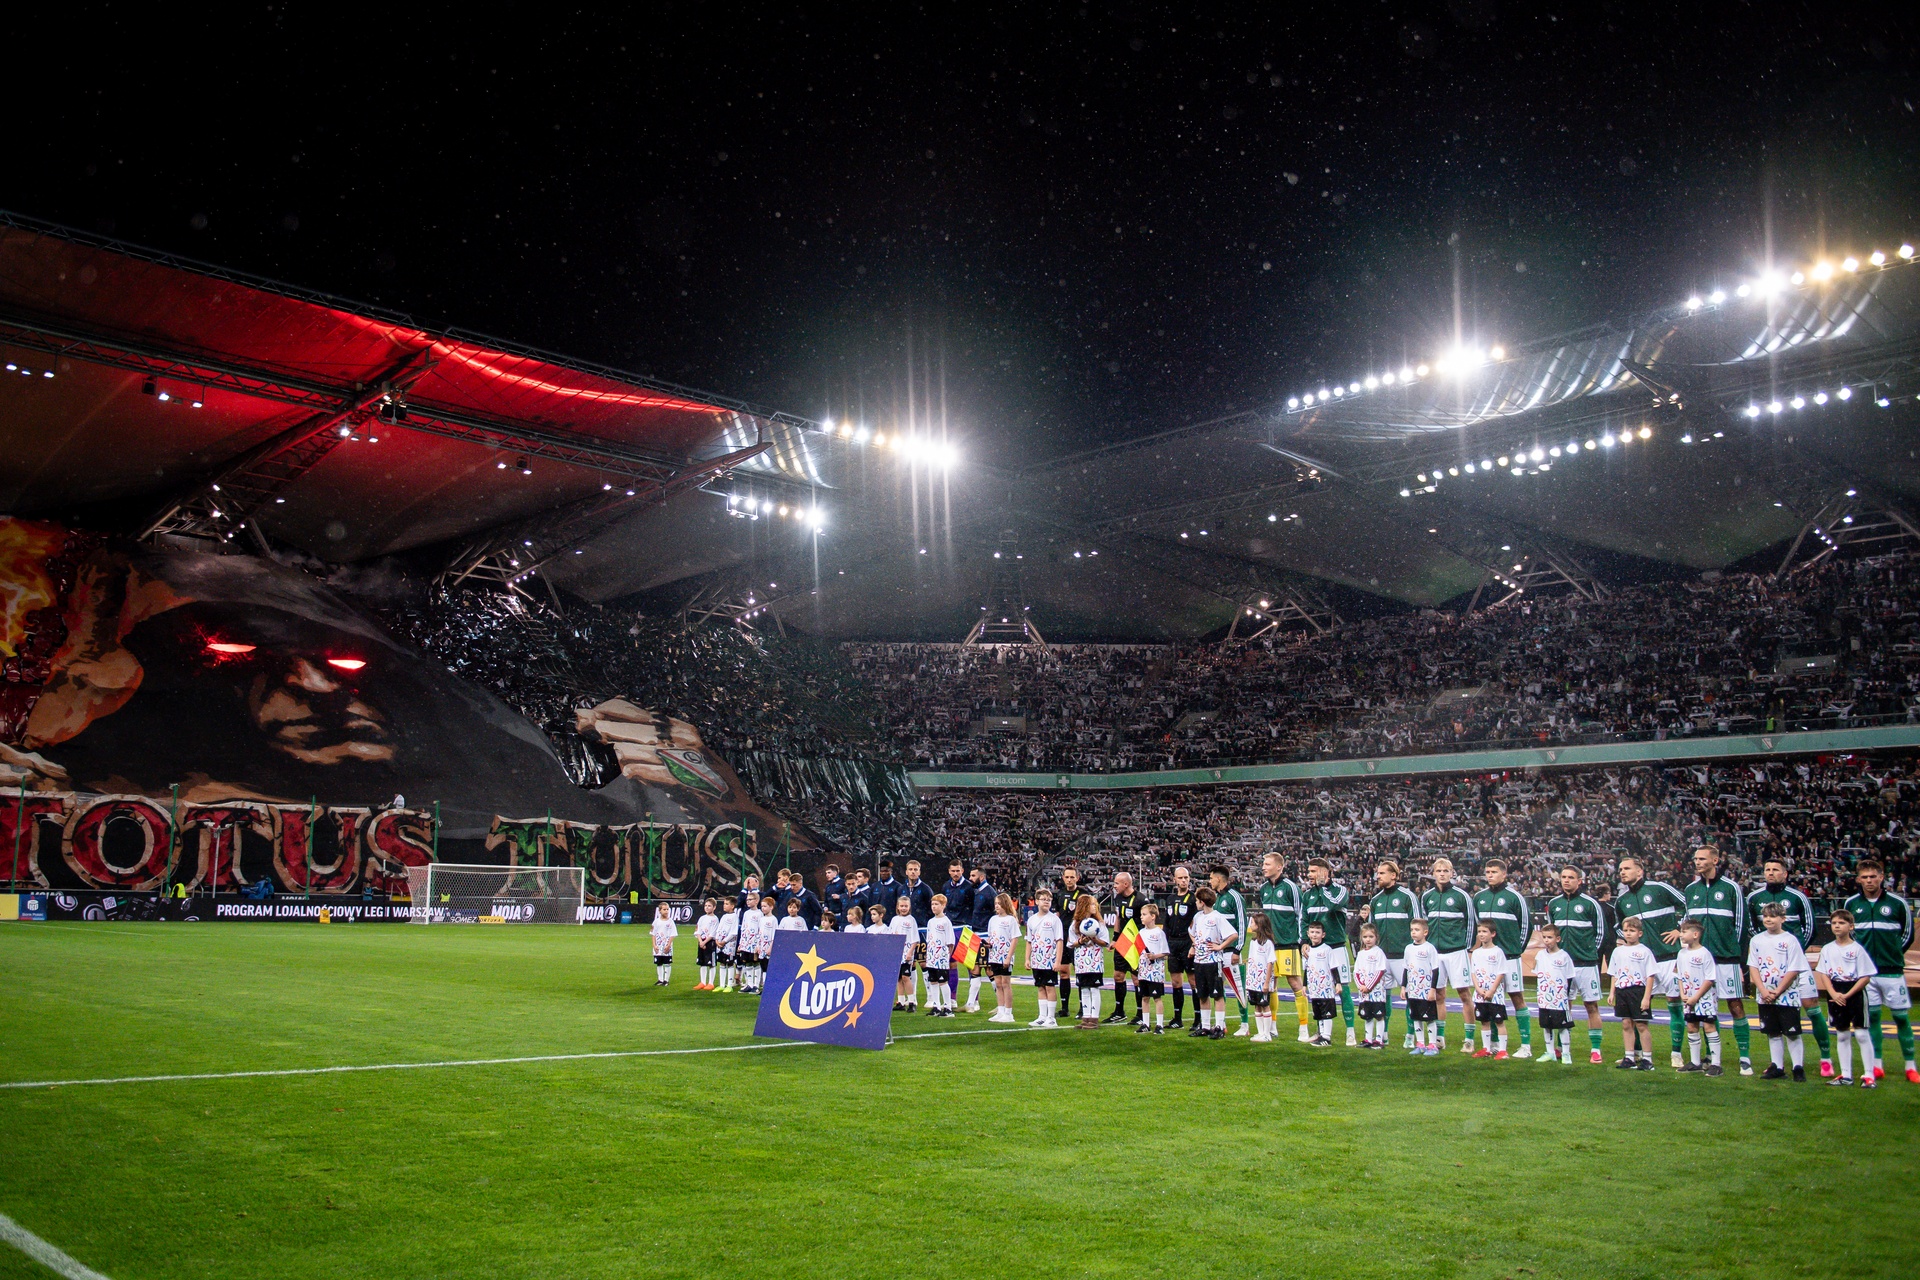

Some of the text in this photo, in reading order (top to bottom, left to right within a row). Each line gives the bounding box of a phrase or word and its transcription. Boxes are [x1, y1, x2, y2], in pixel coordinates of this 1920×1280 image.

[986, 776, 1026, 785] legia.com
[217, 904, 273, 917] PROGRAM
[393, 905, 450, 918] WARSZAW
[491, 904, 521, 920] MOJA
[576, 905, 604, 921] MOJA
[980, 946, 986, 957] 9
[799, 976, 856, 1015] LOTTO
